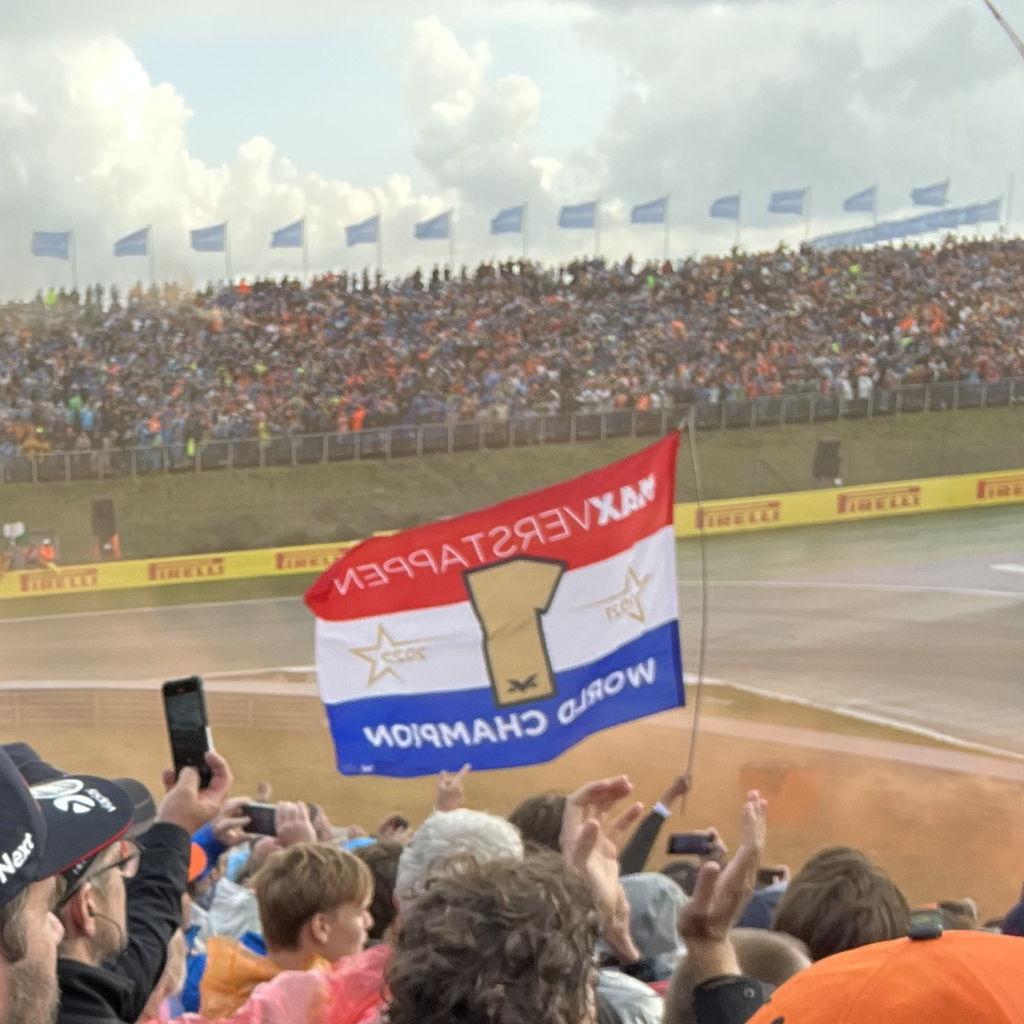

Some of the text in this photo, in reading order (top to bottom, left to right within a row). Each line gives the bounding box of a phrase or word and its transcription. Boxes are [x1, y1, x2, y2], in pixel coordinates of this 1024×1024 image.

[977, 474, 1024, 499] PIRE
[837, 486, 921, 513] PIRELLI
[696, 500, 780, 529] PIRELLI
[20, 567, 98, 592] PIRELLI
[148, 557, 224, 581] PIRELLI
